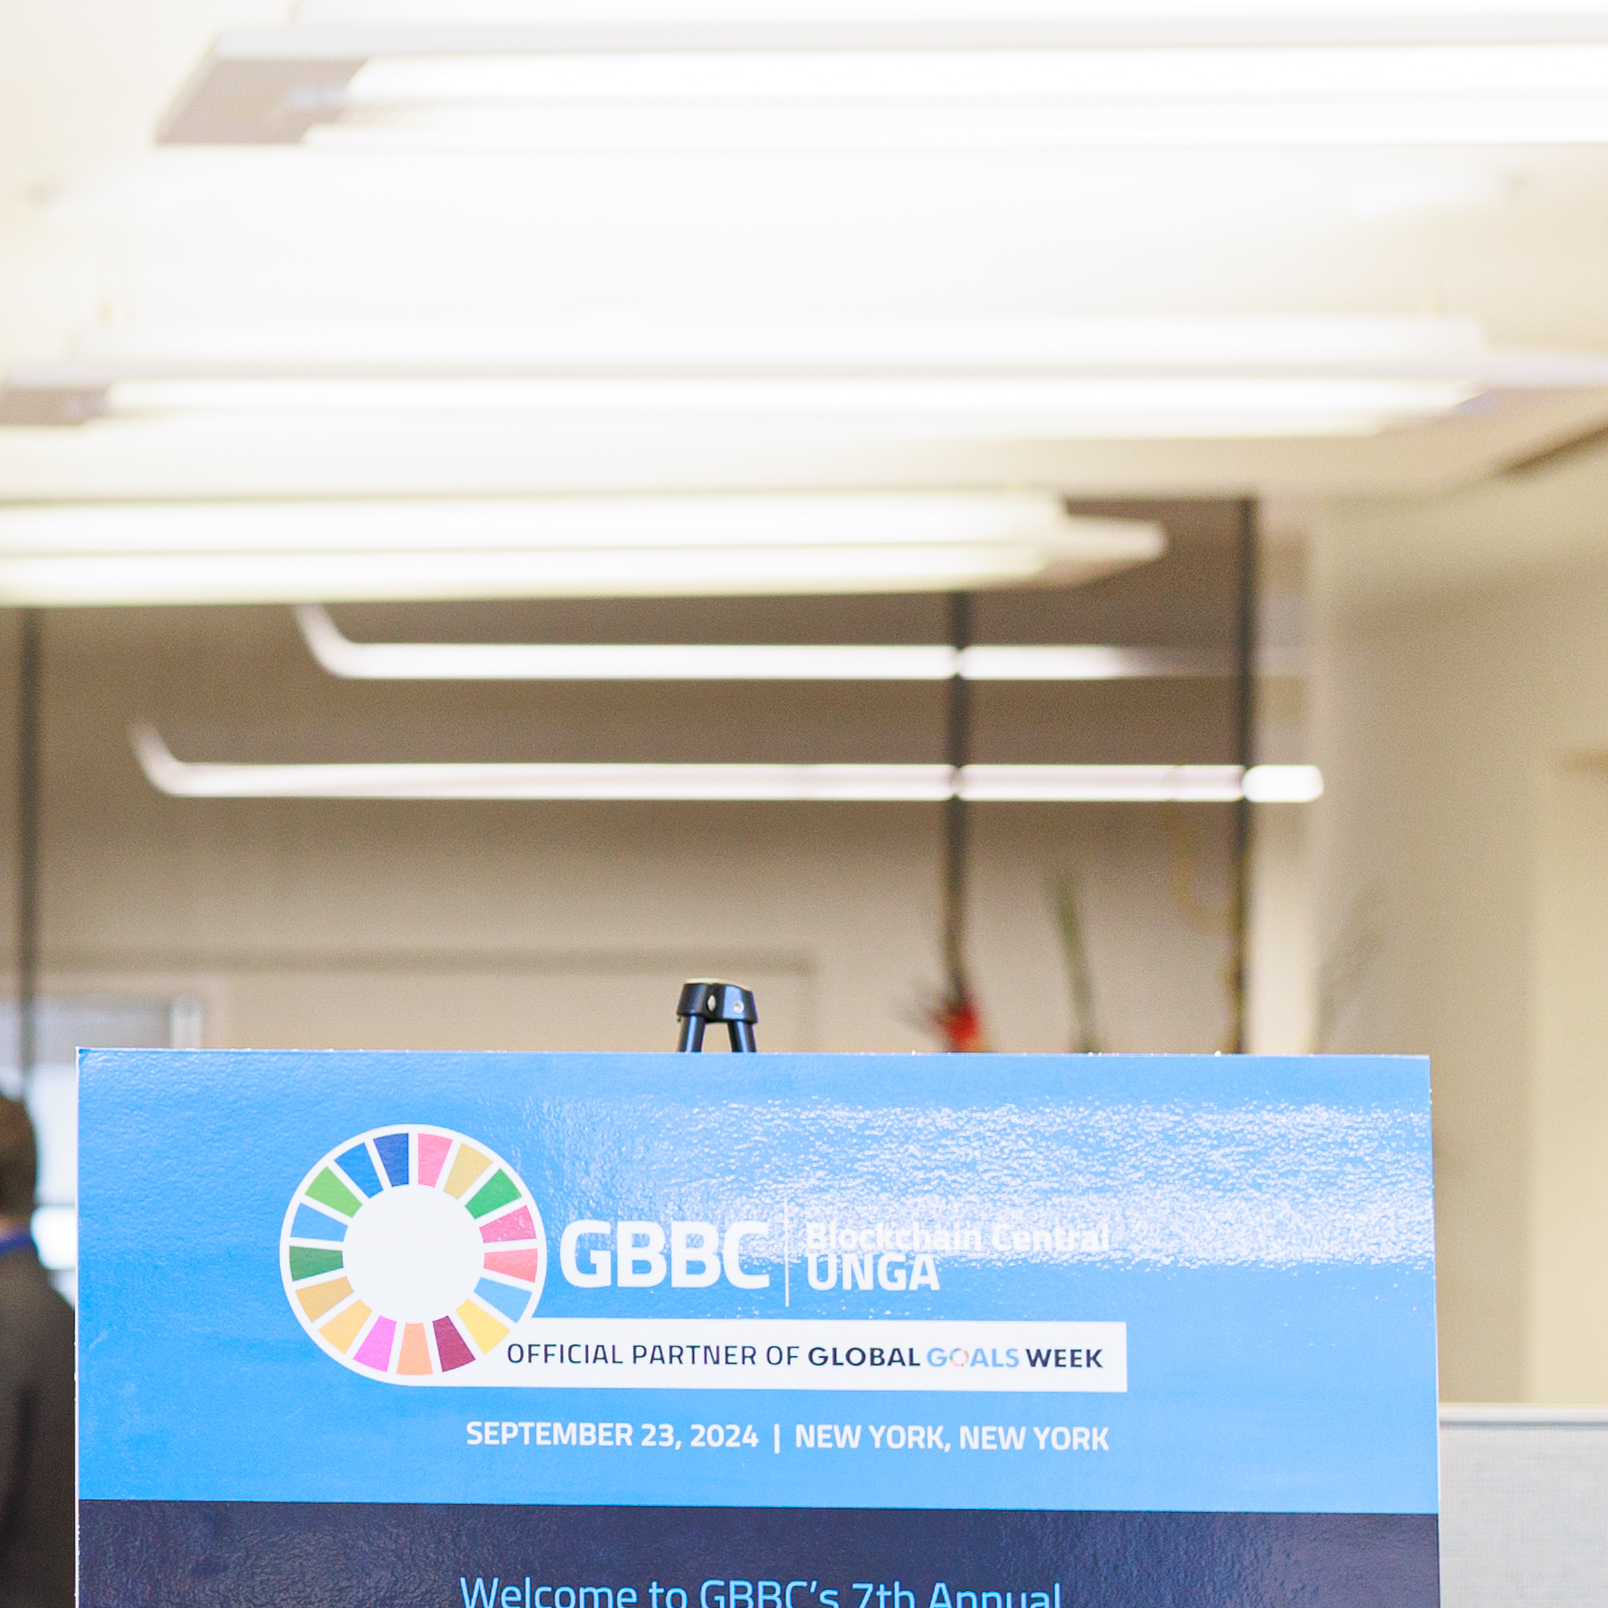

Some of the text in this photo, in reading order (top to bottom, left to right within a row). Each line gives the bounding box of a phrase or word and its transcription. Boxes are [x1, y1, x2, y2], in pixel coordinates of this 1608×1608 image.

[805, 1221, 1111, 1254] Blockchain Central
[560, 1220, 771, 1289] GBBC
[806, 1253, 941, 1292] UNGA
[506, 1342, 1105, 1370] OFFICIAL PARTNER OF GLOBAL GOALS WEEK
[466, 1421, 634, 1448] SEPTEMBER
[641, 1422, 683, 1453] 23,
[690, 1423, 760, 1449] 2024
[795, 1424, 861, 1449] NEW
[868, 1424, 951, 1454] YORK,
[959, 1425, 1025, 1450] NEW
[1032, 1426, 1111, 1452] YORK
